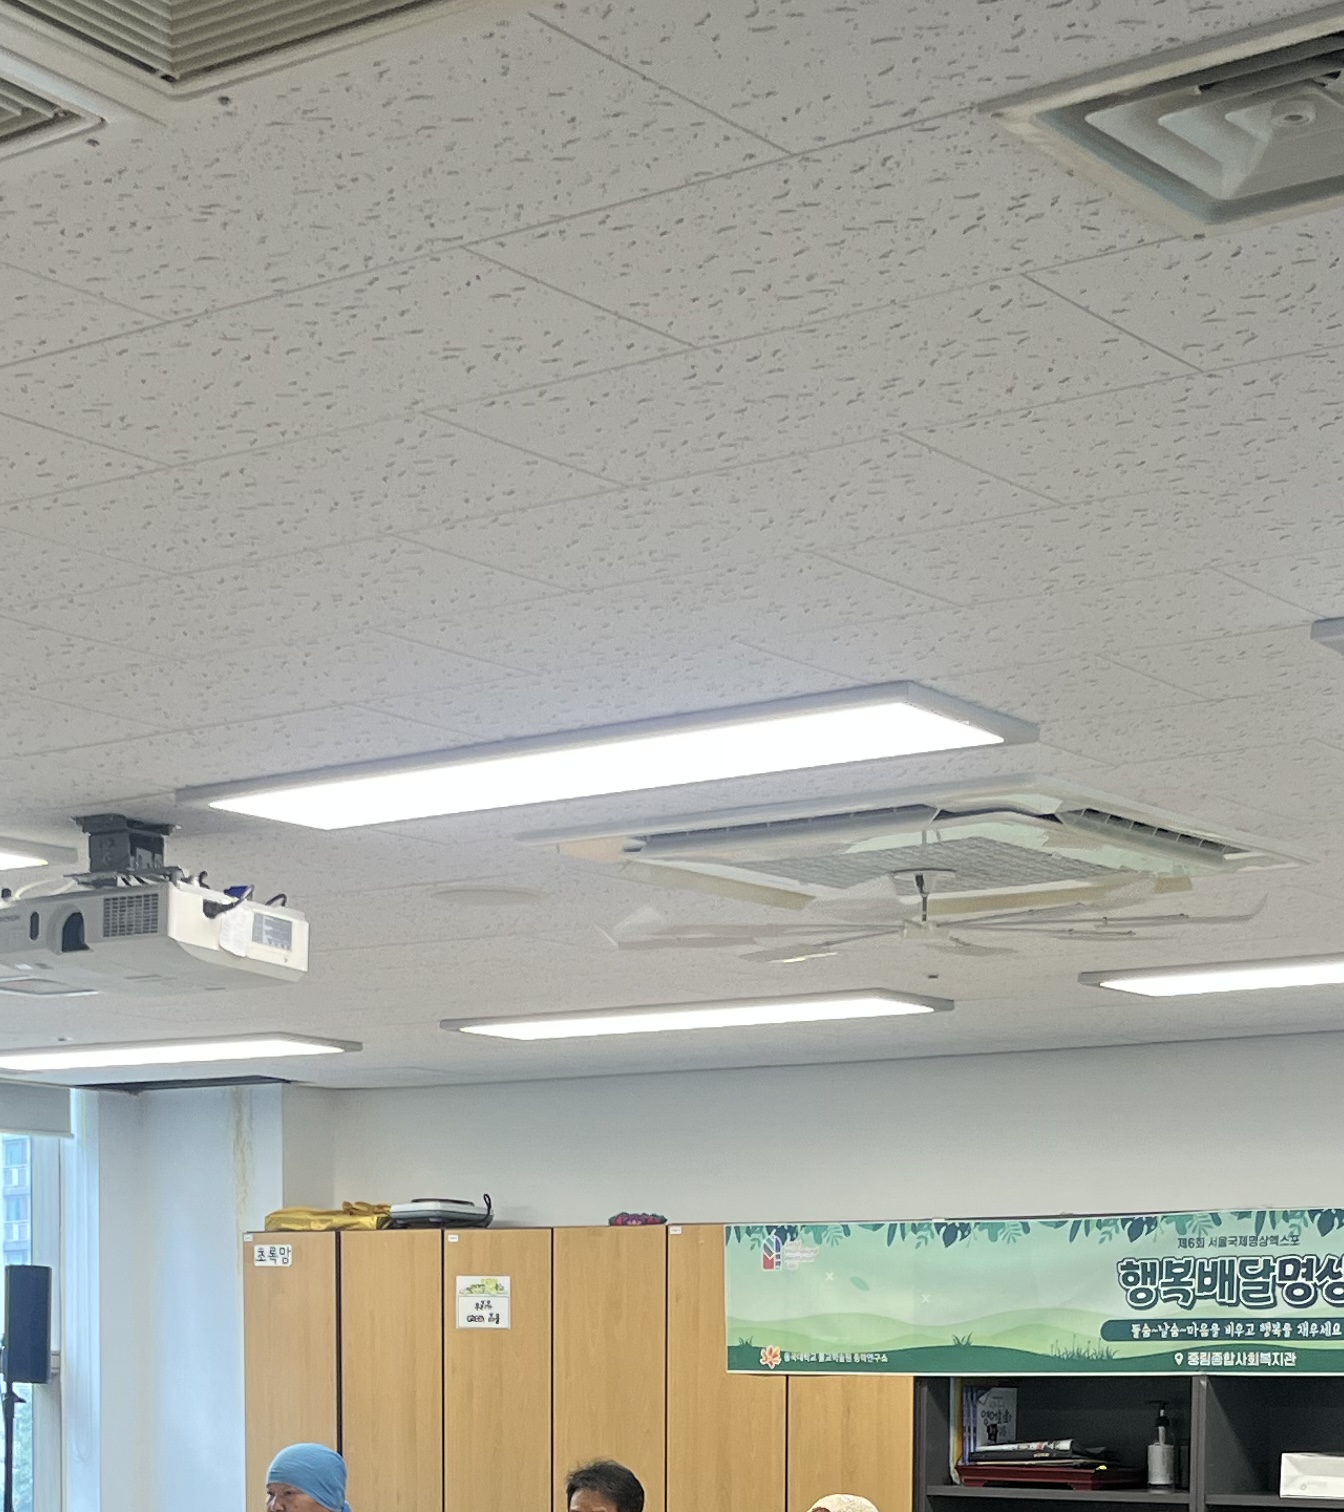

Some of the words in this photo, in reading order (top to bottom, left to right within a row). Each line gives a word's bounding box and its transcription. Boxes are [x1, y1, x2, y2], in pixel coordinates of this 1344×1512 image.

[1177, 1237, 1205, 1249] 제6회
[1224, 1322, 1256, 1339] 비우고
[1259, 1321, 1293, 1339] 행복을
[1297, 1320, 1343, 1338] 채우세요
[1187, 1352, 1297, 1367] 중림종합사회복지관
